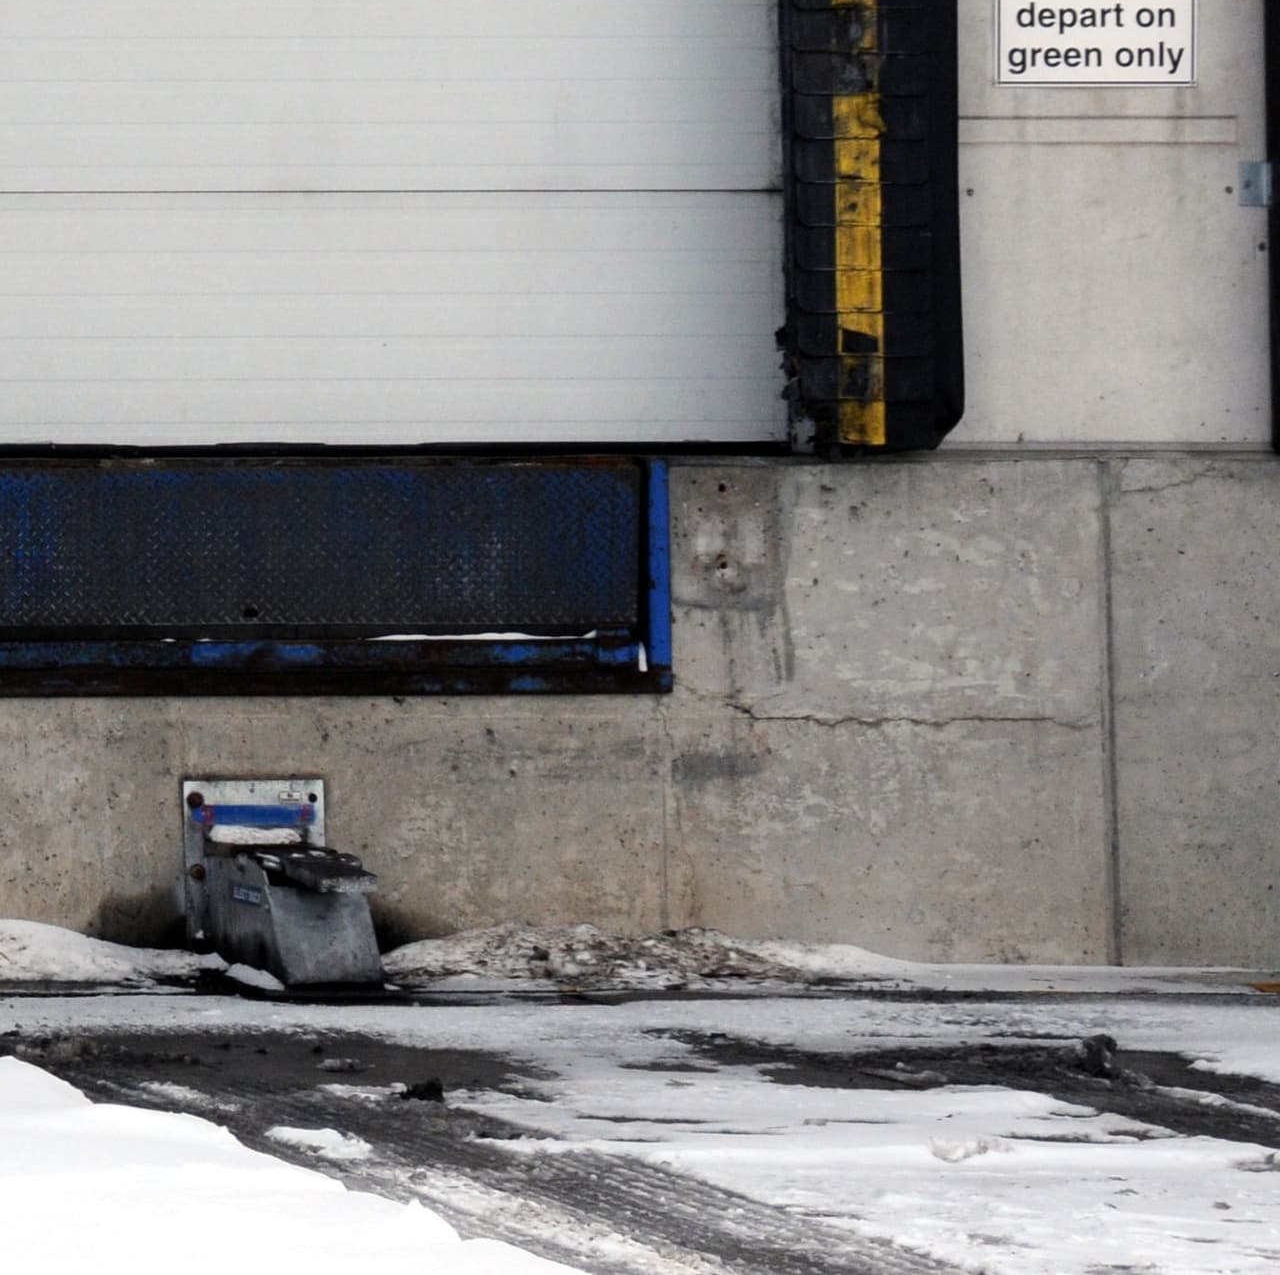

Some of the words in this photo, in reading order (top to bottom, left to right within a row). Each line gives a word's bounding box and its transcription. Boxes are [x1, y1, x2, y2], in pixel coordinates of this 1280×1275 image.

[1016, 1, 1124, 35] depart
[1135, 7, 1176, 28] on
[1007, 47, 1102, 75] green
[1115, 41, 1185, 75] only
